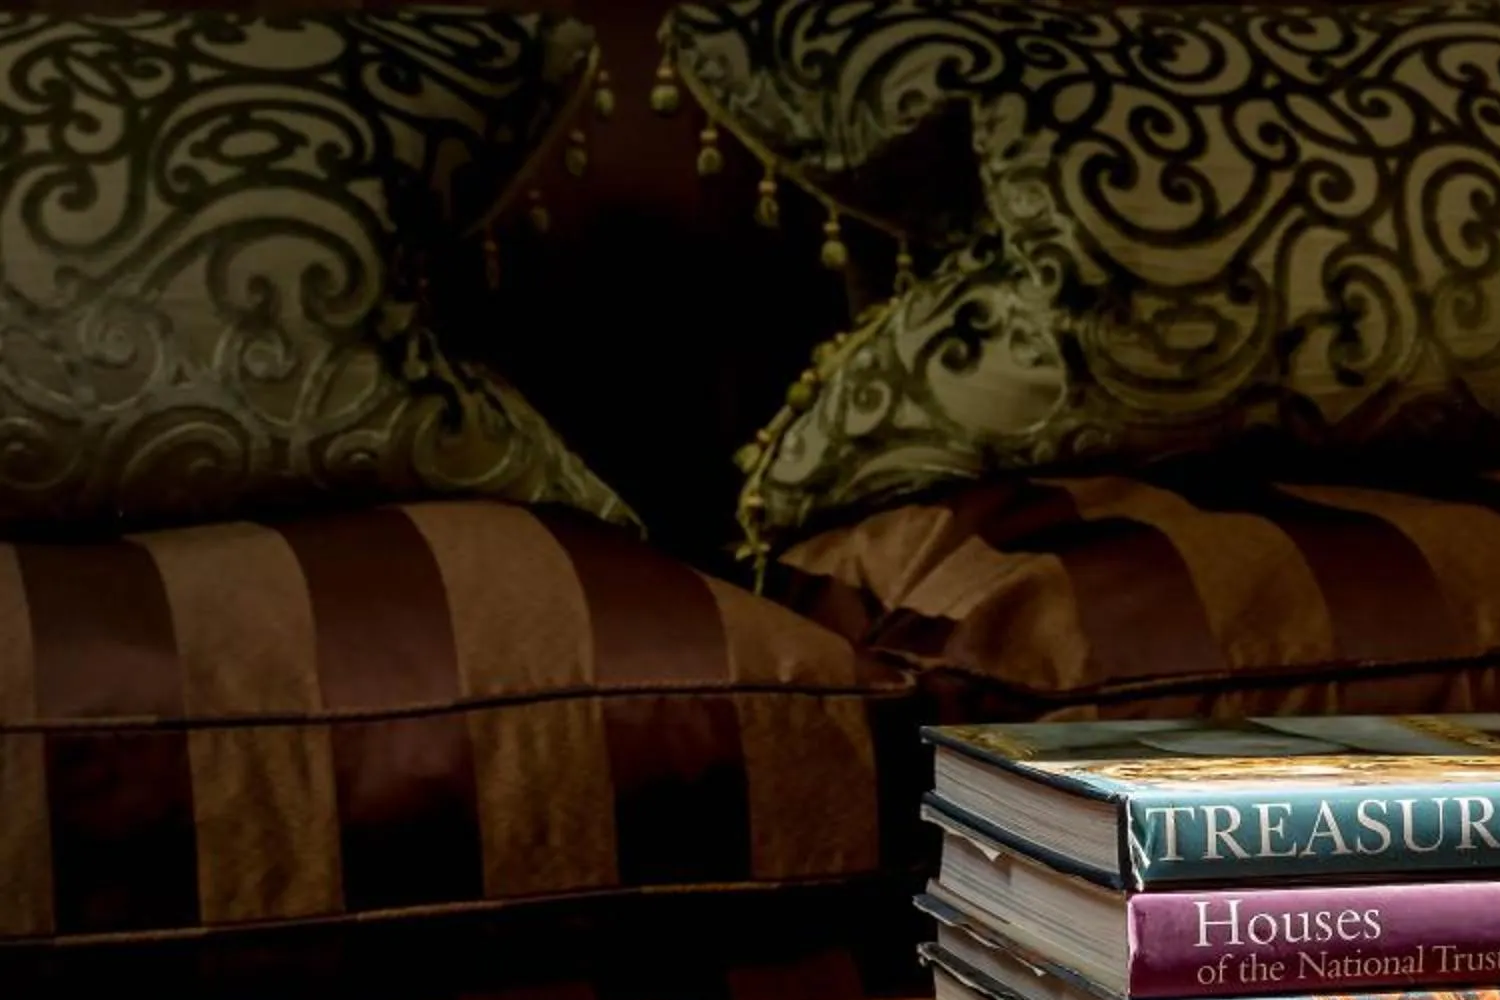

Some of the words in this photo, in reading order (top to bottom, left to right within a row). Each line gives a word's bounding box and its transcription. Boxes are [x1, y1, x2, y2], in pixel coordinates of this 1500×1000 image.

[1193, 899, 1382, 947] Houses
[1197, 954, 1233, 985] of
[1239, 956, 1285, 983] the
[1299, 946, 1424, 979] National
